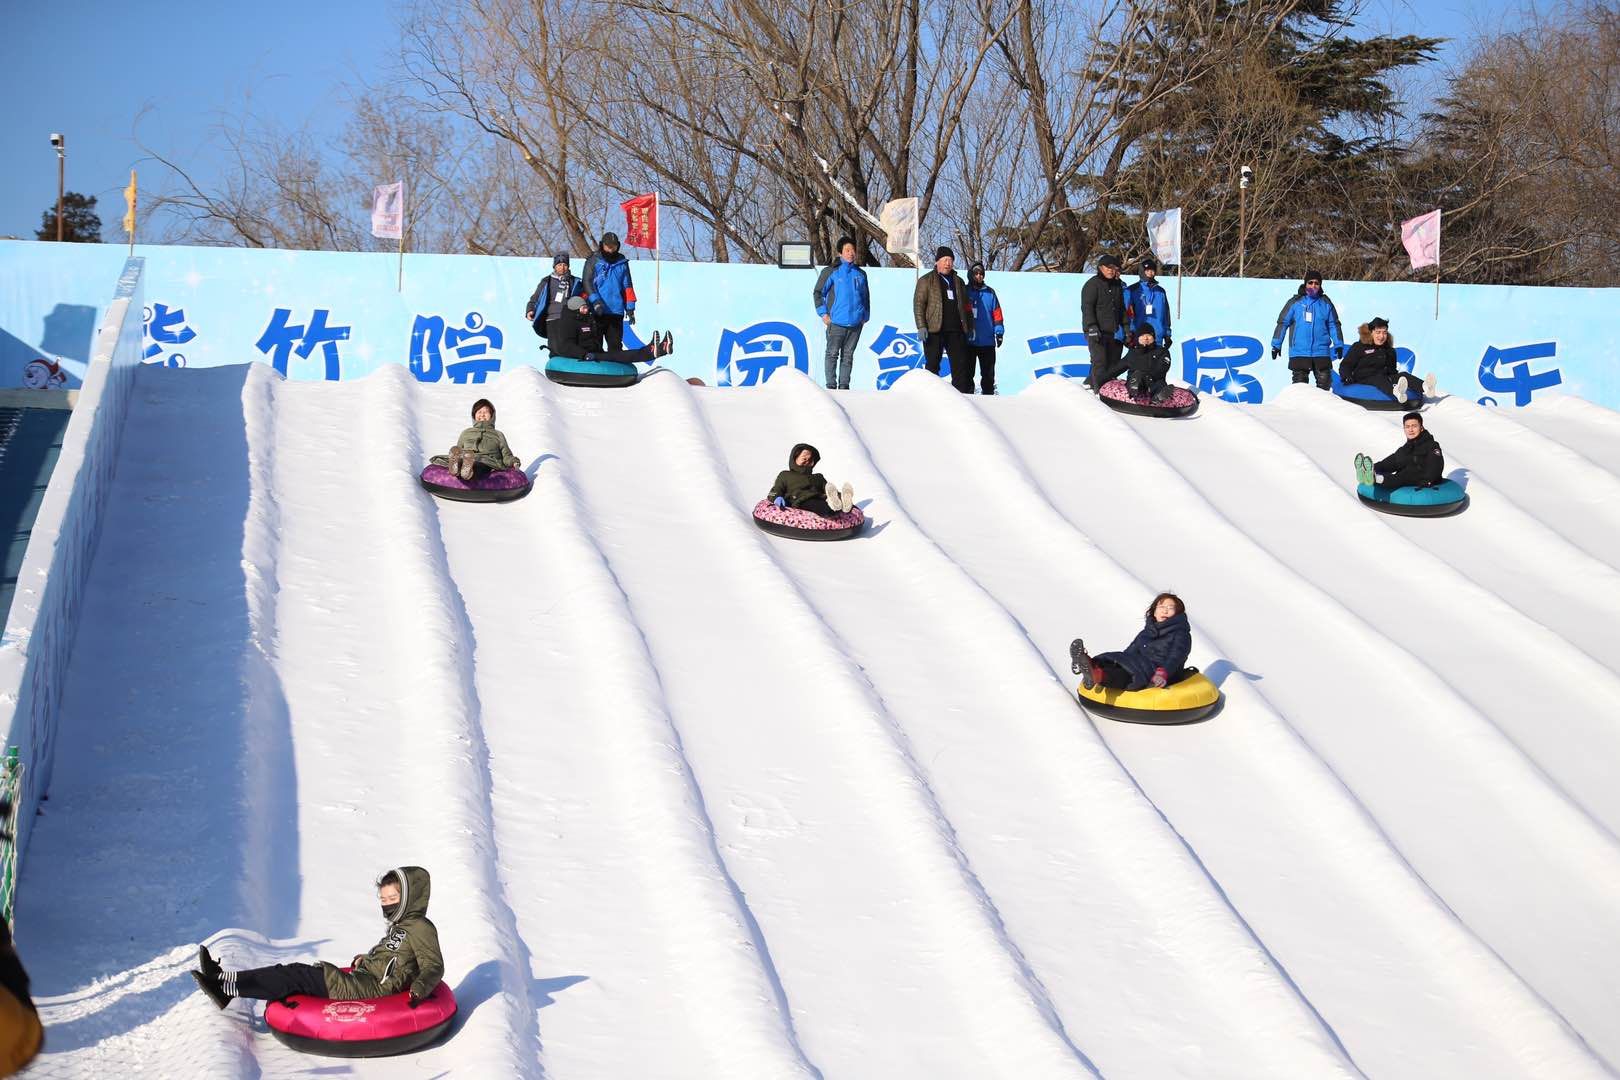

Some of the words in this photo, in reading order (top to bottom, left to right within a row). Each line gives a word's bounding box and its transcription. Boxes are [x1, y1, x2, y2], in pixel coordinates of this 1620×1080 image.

[98, 302, 1561, 406] 竹院园届乐
